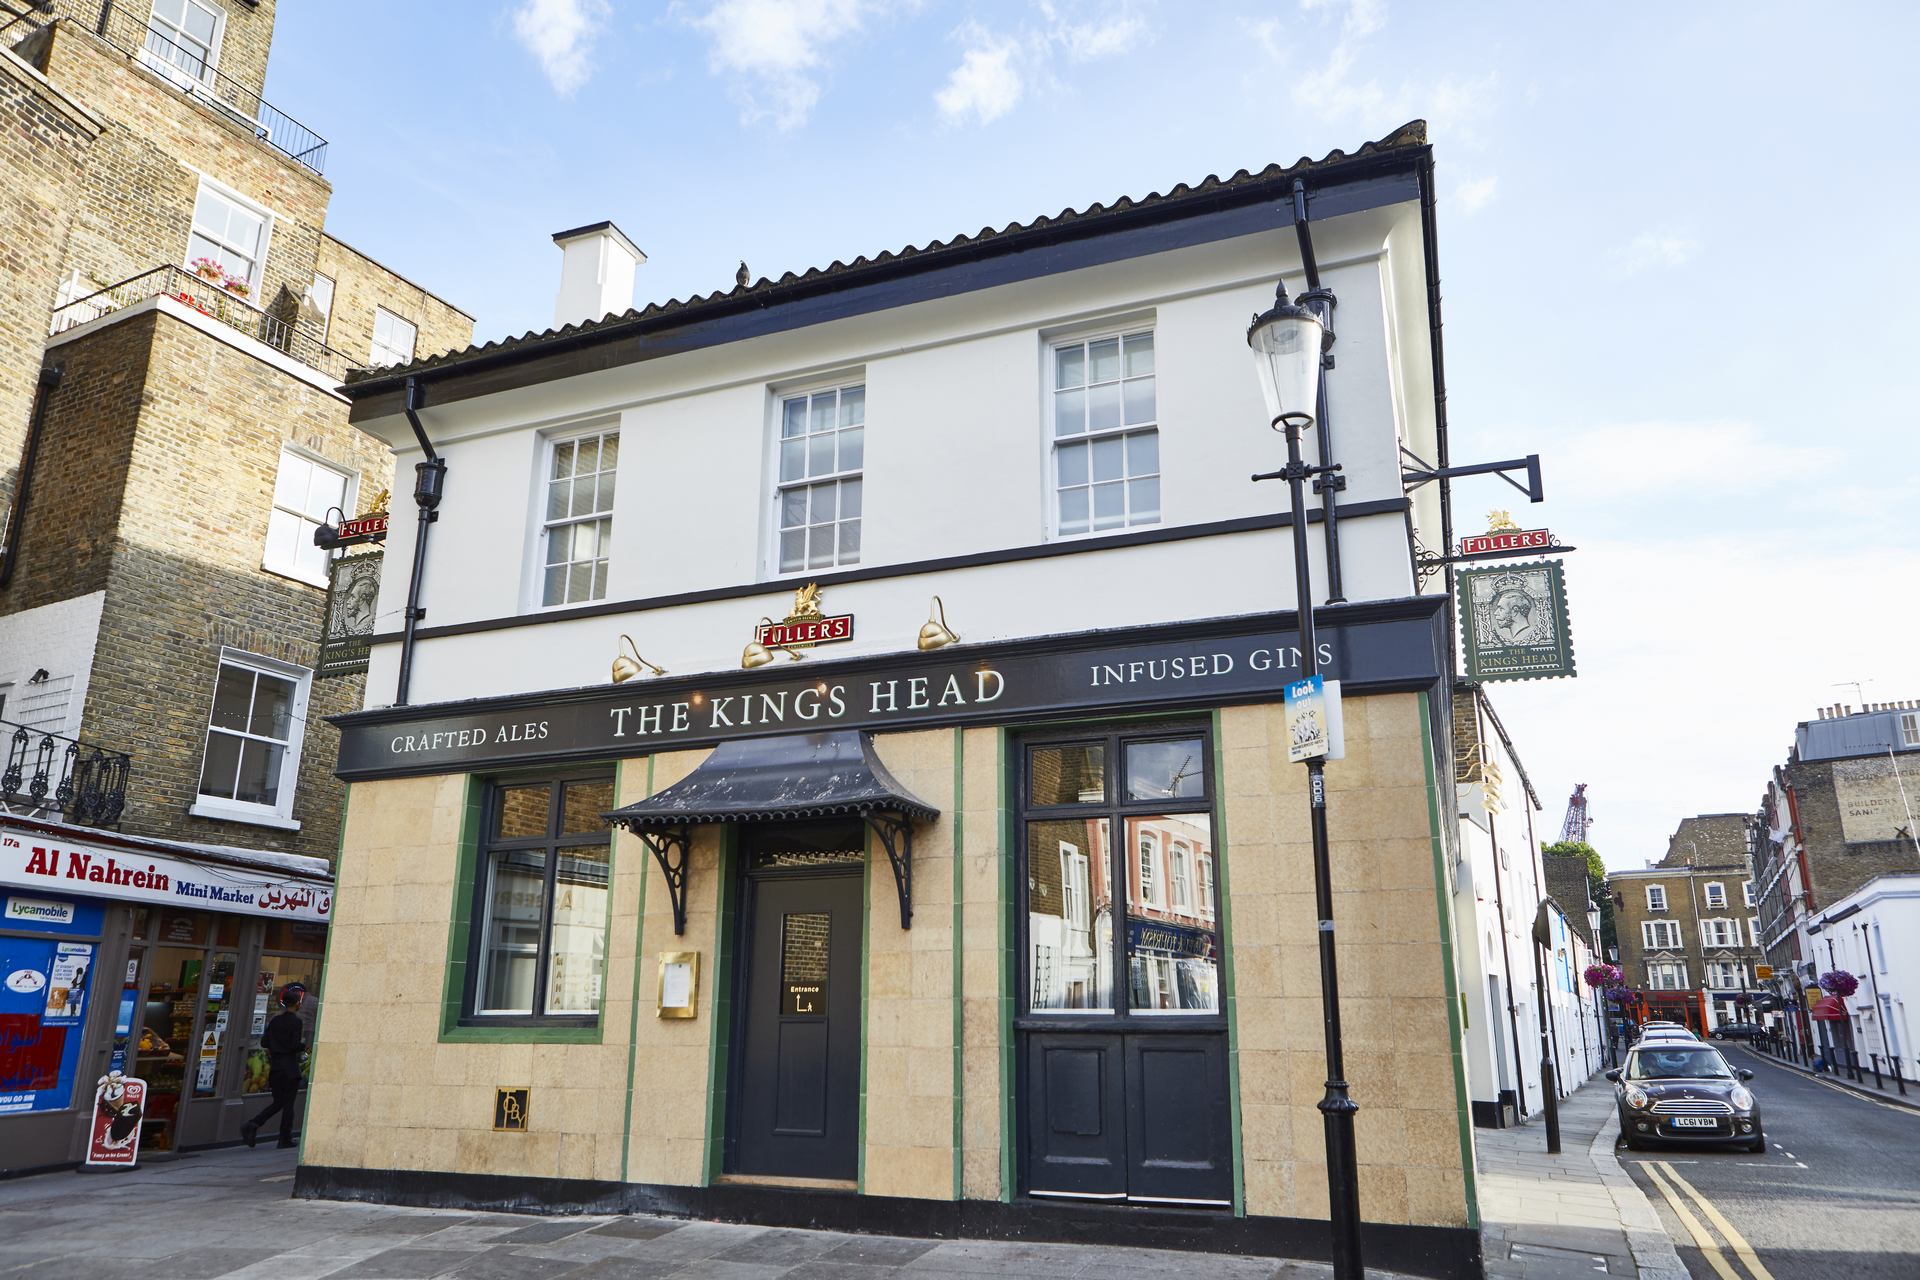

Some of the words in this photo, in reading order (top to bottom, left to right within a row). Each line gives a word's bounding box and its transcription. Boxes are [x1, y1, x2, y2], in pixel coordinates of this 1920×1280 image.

[1466, 531, 1544, 552] FULLER'S
[760, 620, 844, 644] FULLER'S
[348, 639, 362, 647] THE
[1090, 653, 1234, 686] INFUSED
[1480, 656, 1518, 667] KINGS
[1522, 653, 1557, 664] HEAD
[1291, 680, 1315, 699] Look
[610, 702, 690, 737] THE
[709, 685, 846, 728] KINGS
[868, 670, 1005, 713] HEAD
[390, 728, 487, 753] CRAFTED
[494, 721, 549, 743] ALES
[3, 838, 20, 848] 17a
[25, 847, 60, 877] Al
[66, 852, 170, 891] Nahrein
[175, 880, 209, 899] Mini
[209, 886, 254, 904] Market
[12, 902, 68, 918] Lycamobile
[1678, 1118, 1697, 1126] LC61
